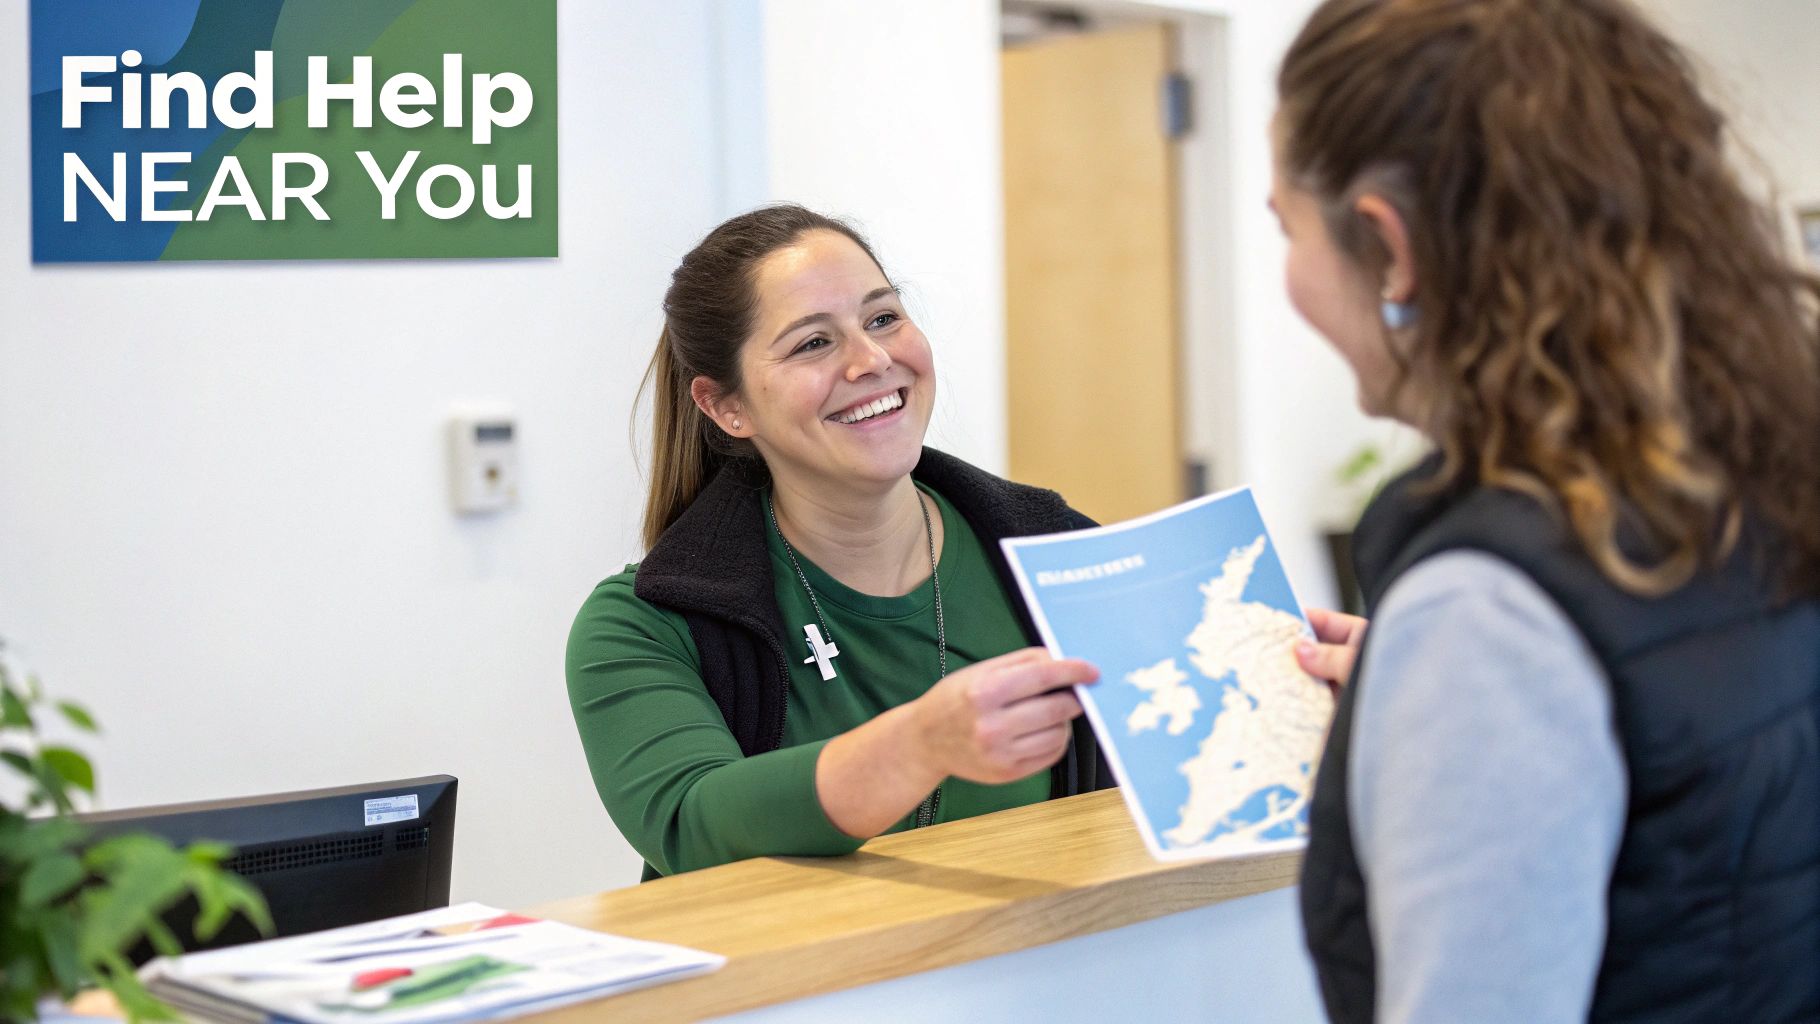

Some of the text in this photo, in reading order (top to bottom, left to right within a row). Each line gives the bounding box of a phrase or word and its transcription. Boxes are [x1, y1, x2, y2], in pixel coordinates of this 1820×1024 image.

[62, 50, 533, 144] Find Help
[63, 151, 532, 222] NEAR You
